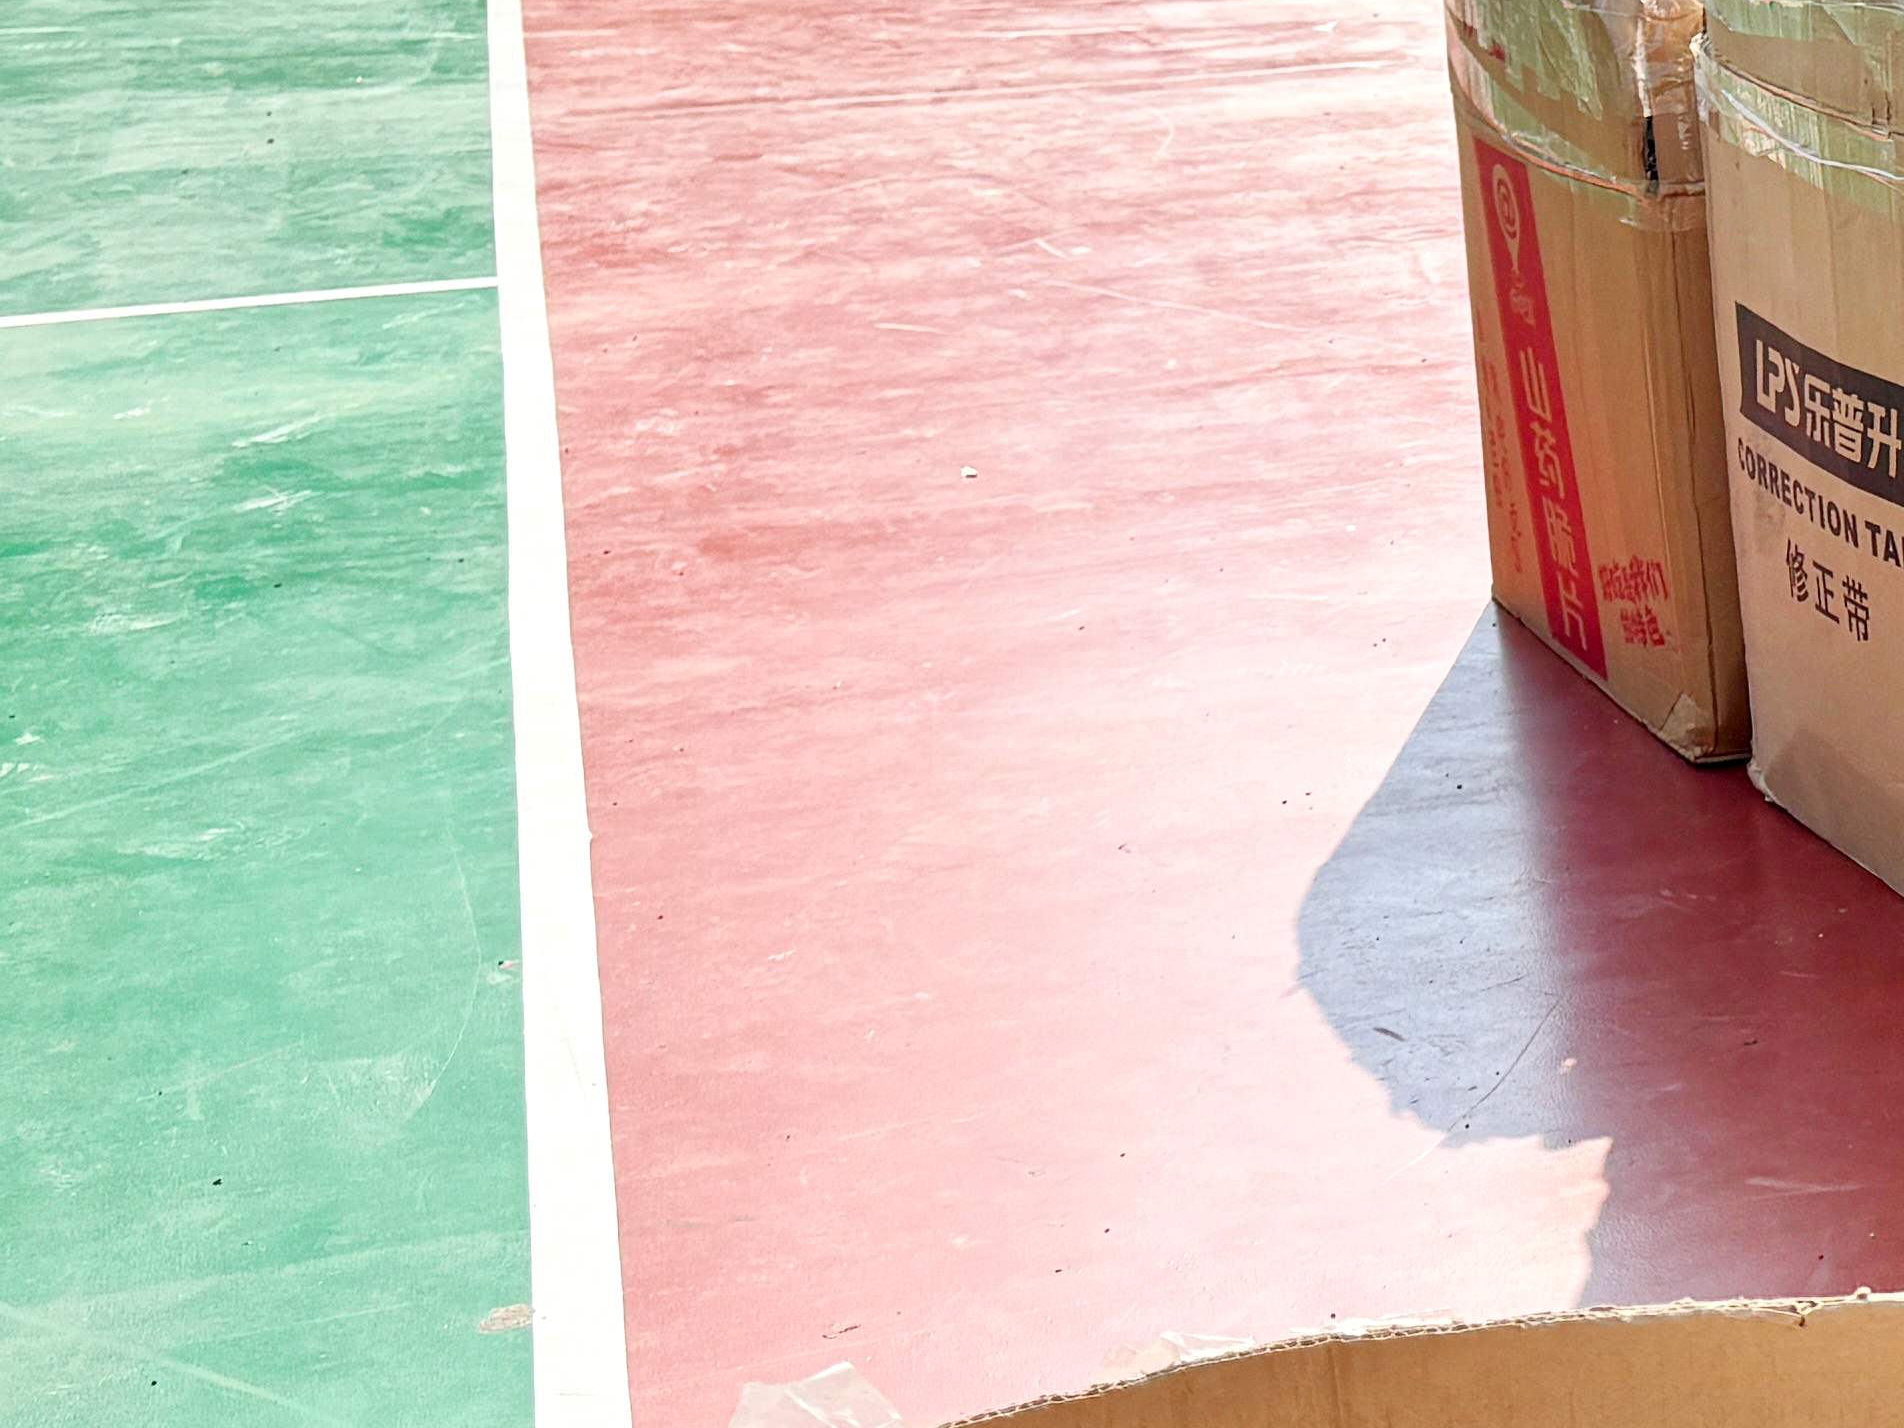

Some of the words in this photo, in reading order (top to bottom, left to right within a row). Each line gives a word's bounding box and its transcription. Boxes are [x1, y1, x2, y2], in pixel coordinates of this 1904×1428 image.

[1737, 437, 1859, 549] CORRECTION
[1785, 538, 1871, 642] 修正带
